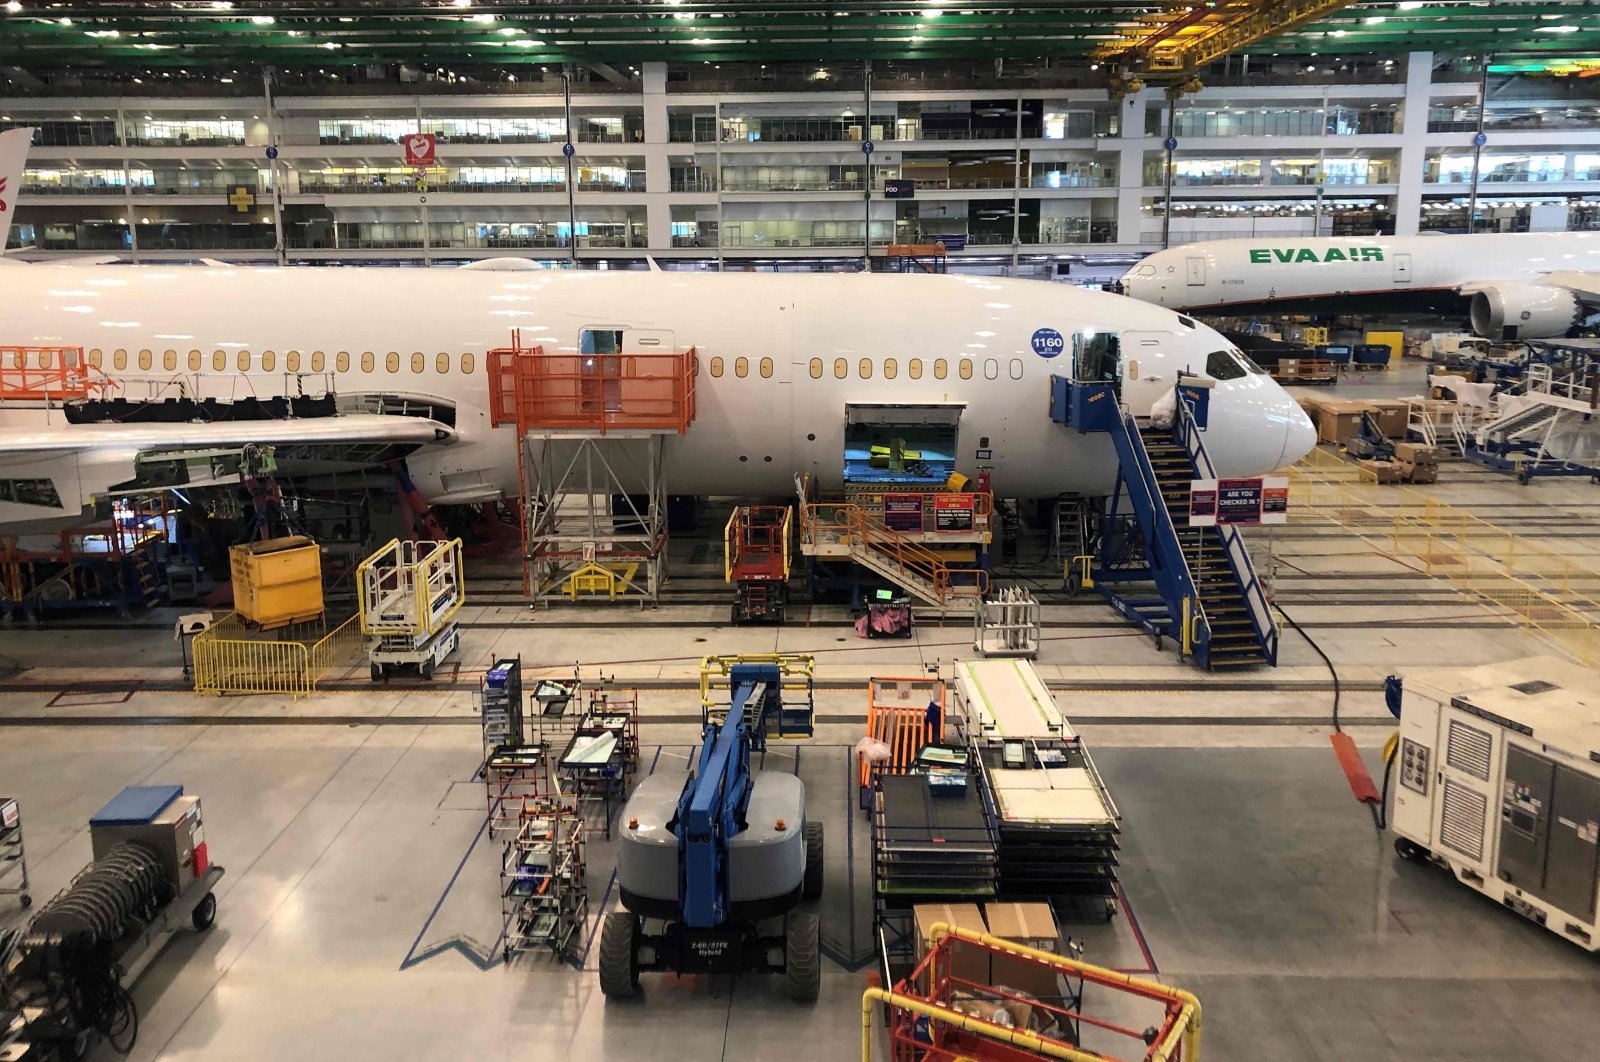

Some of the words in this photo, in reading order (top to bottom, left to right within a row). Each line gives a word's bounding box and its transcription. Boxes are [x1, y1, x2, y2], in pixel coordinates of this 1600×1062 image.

[1250, 248, 1319, 263] EVA
[1324, 247, 1385, 262] AIR
[1033, 337, 1062, 347] 1160
[584, 545, 593, 559] 7
